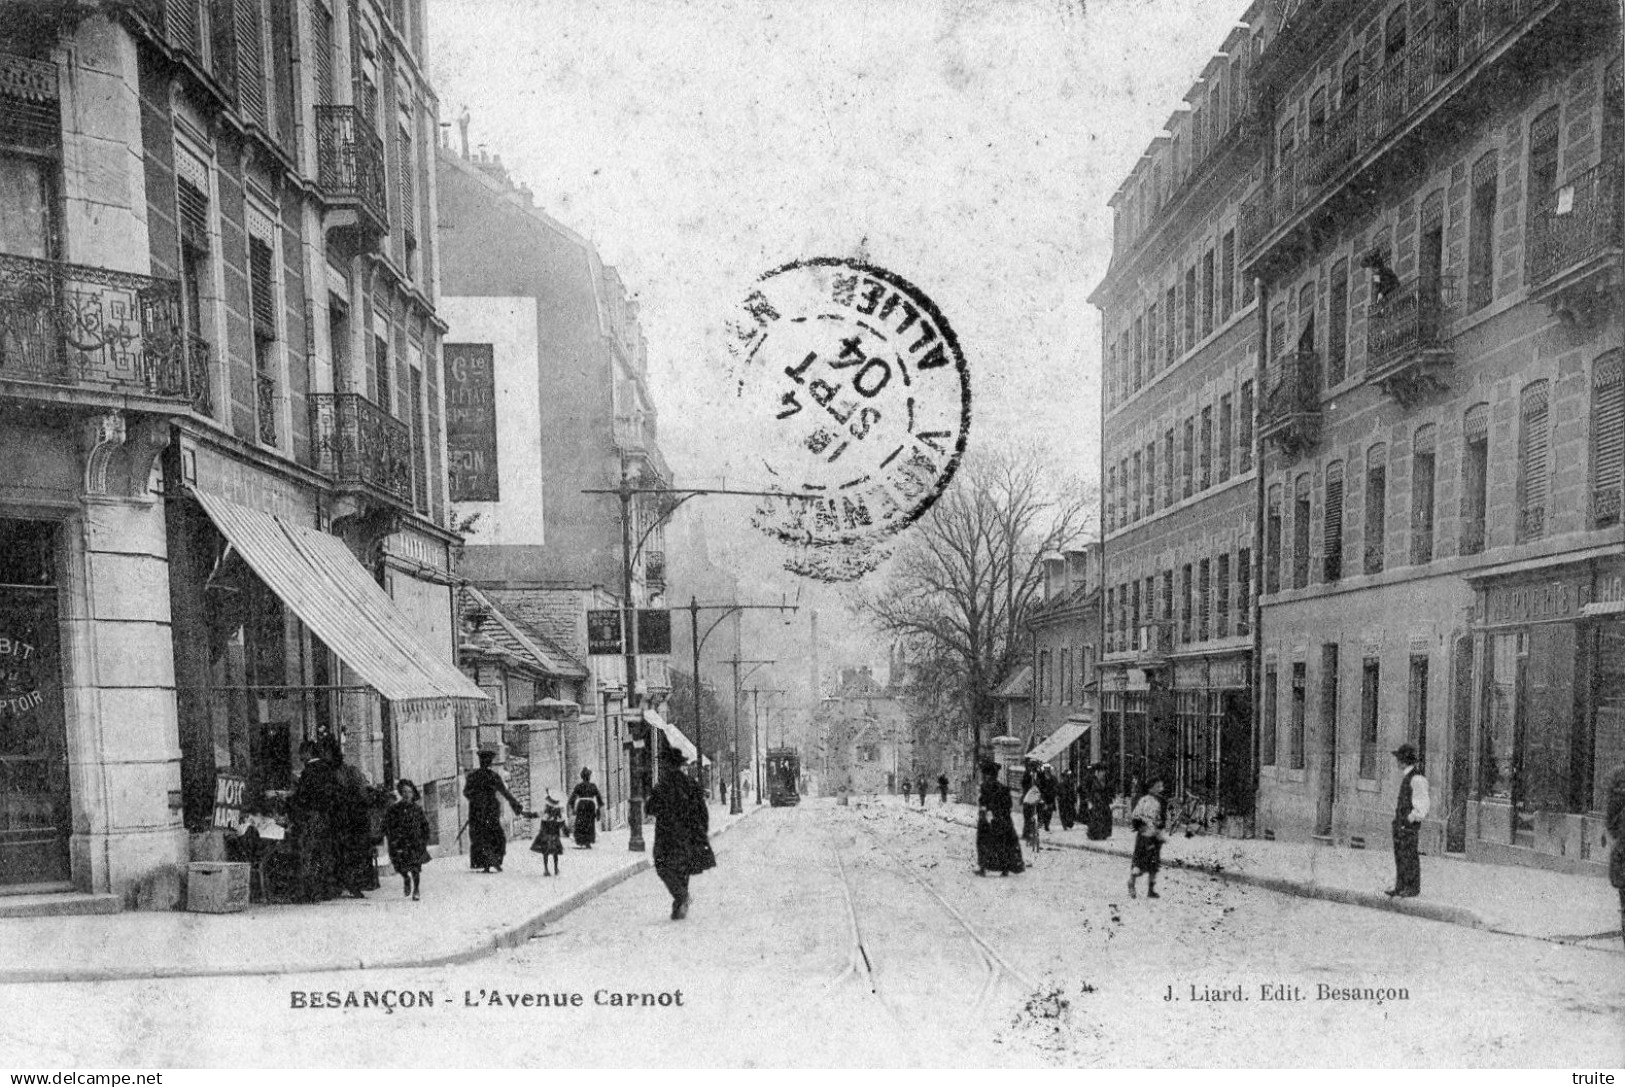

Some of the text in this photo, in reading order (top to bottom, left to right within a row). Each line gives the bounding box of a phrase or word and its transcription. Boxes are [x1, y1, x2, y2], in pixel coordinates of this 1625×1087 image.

[832, 271, 949, 370] ALLIER
[785, 351, 881, 441] SEPT
[829, 336, 891, 398] 04
